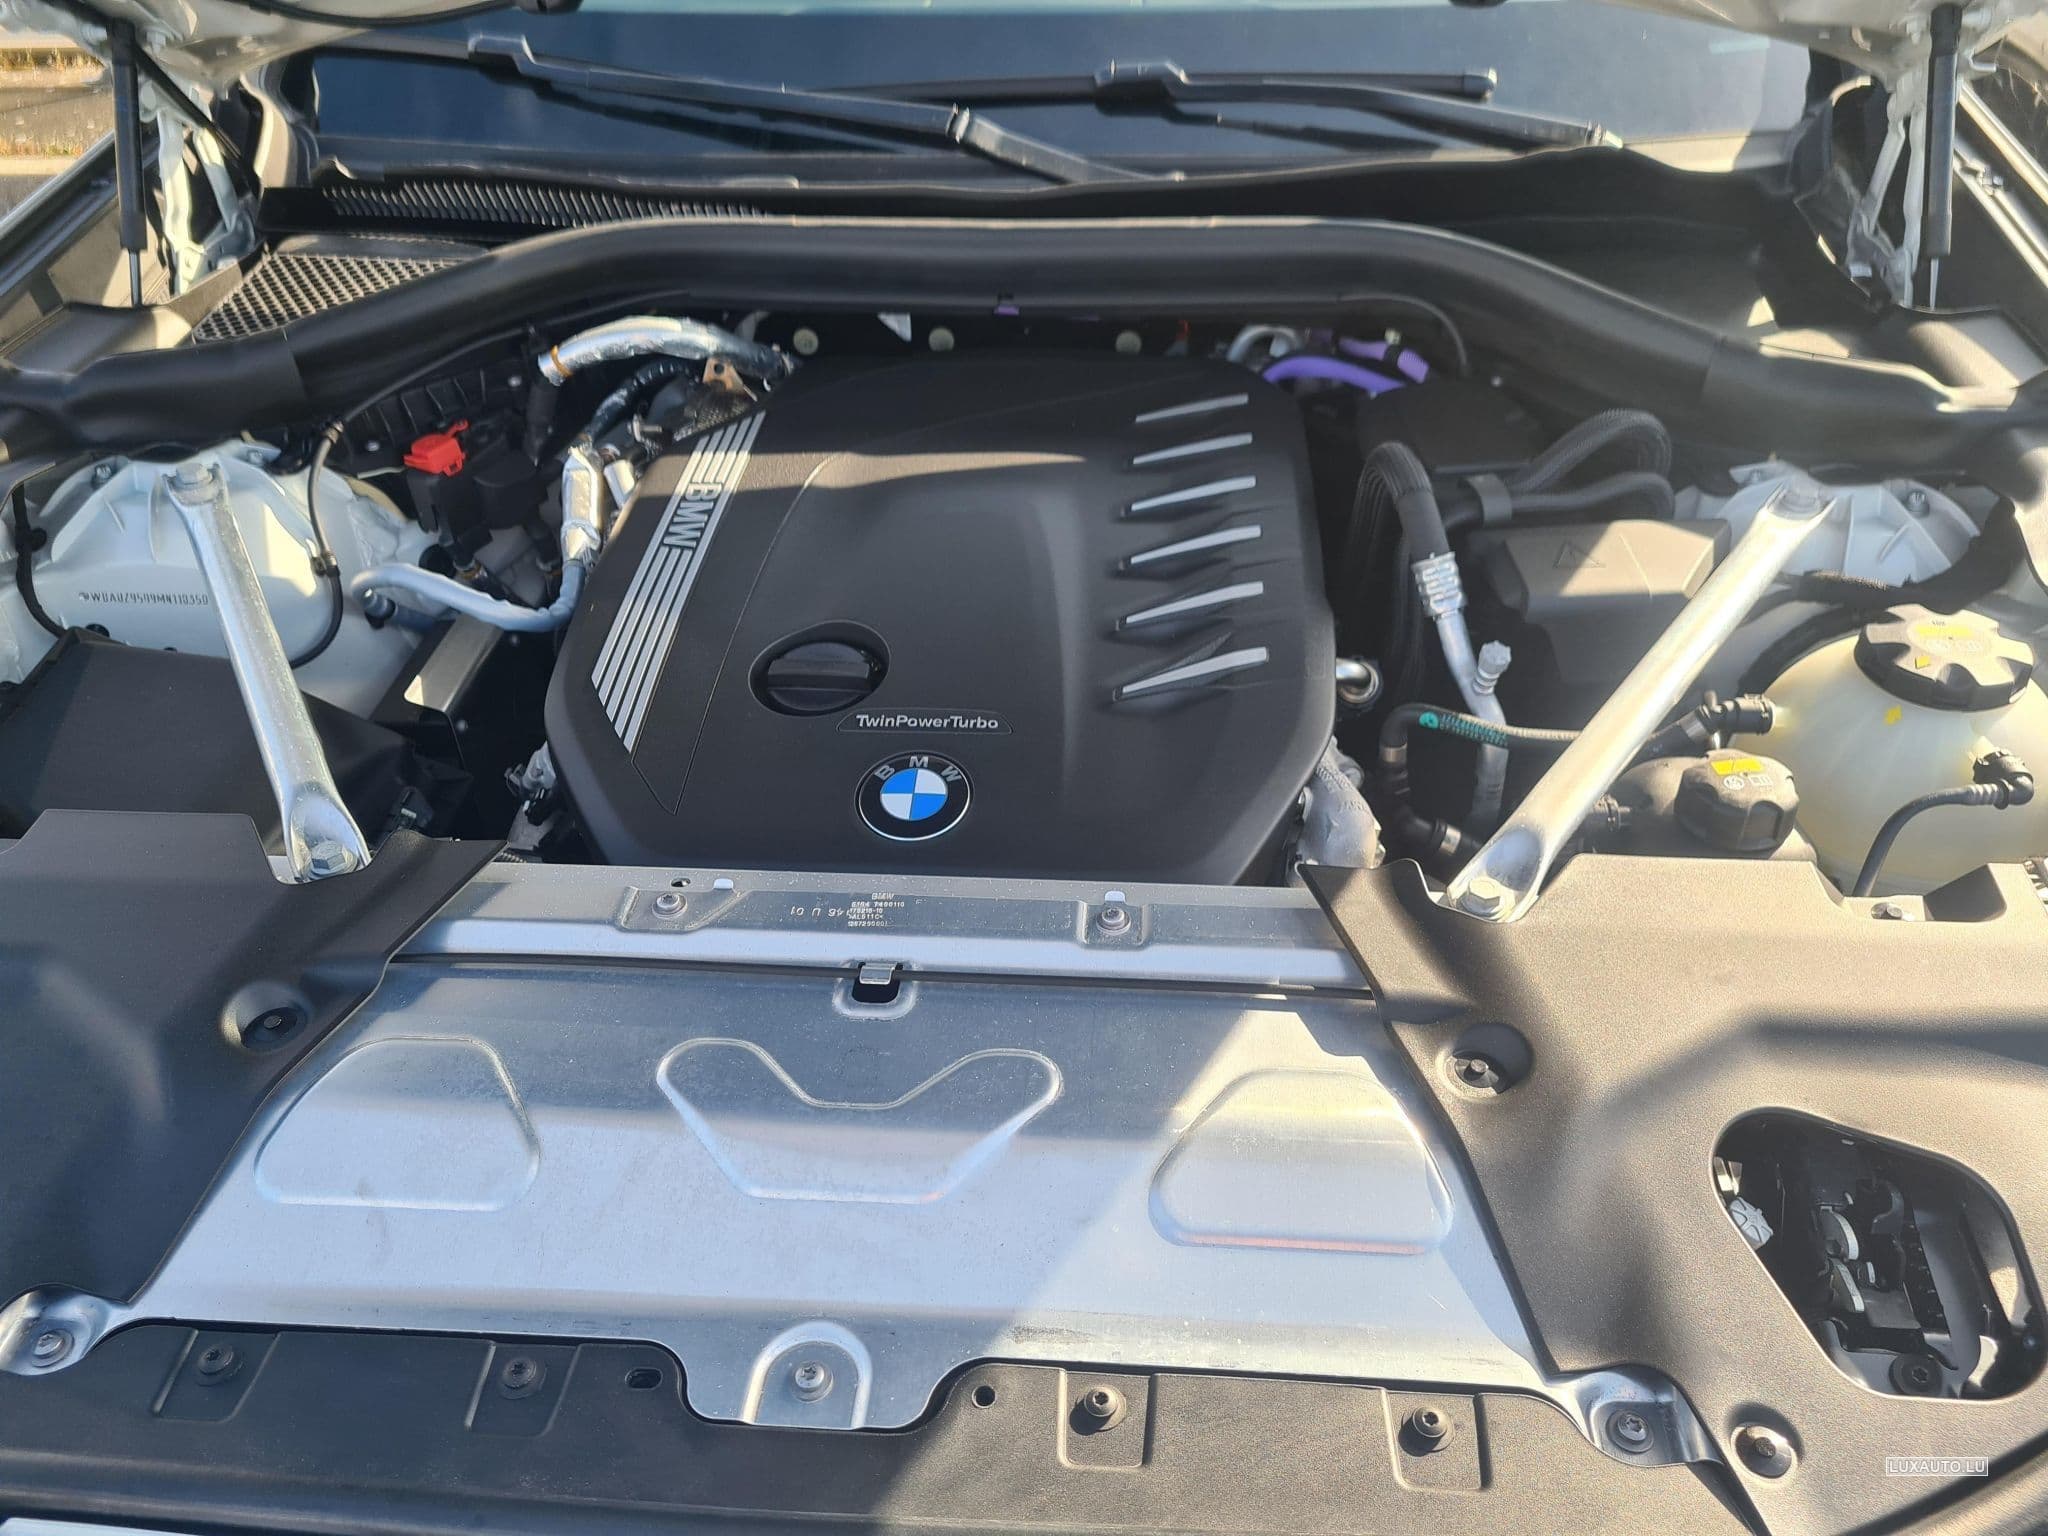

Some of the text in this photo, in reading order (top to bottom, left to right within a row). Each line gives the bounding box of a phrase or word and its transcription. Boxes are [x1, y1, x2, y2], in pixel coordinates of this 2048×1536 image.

[663, 483, 723, 548] BMW
[856, 714, 999, 729] TwinPowerTurbo
[874, 756, 962, 782] BMW
